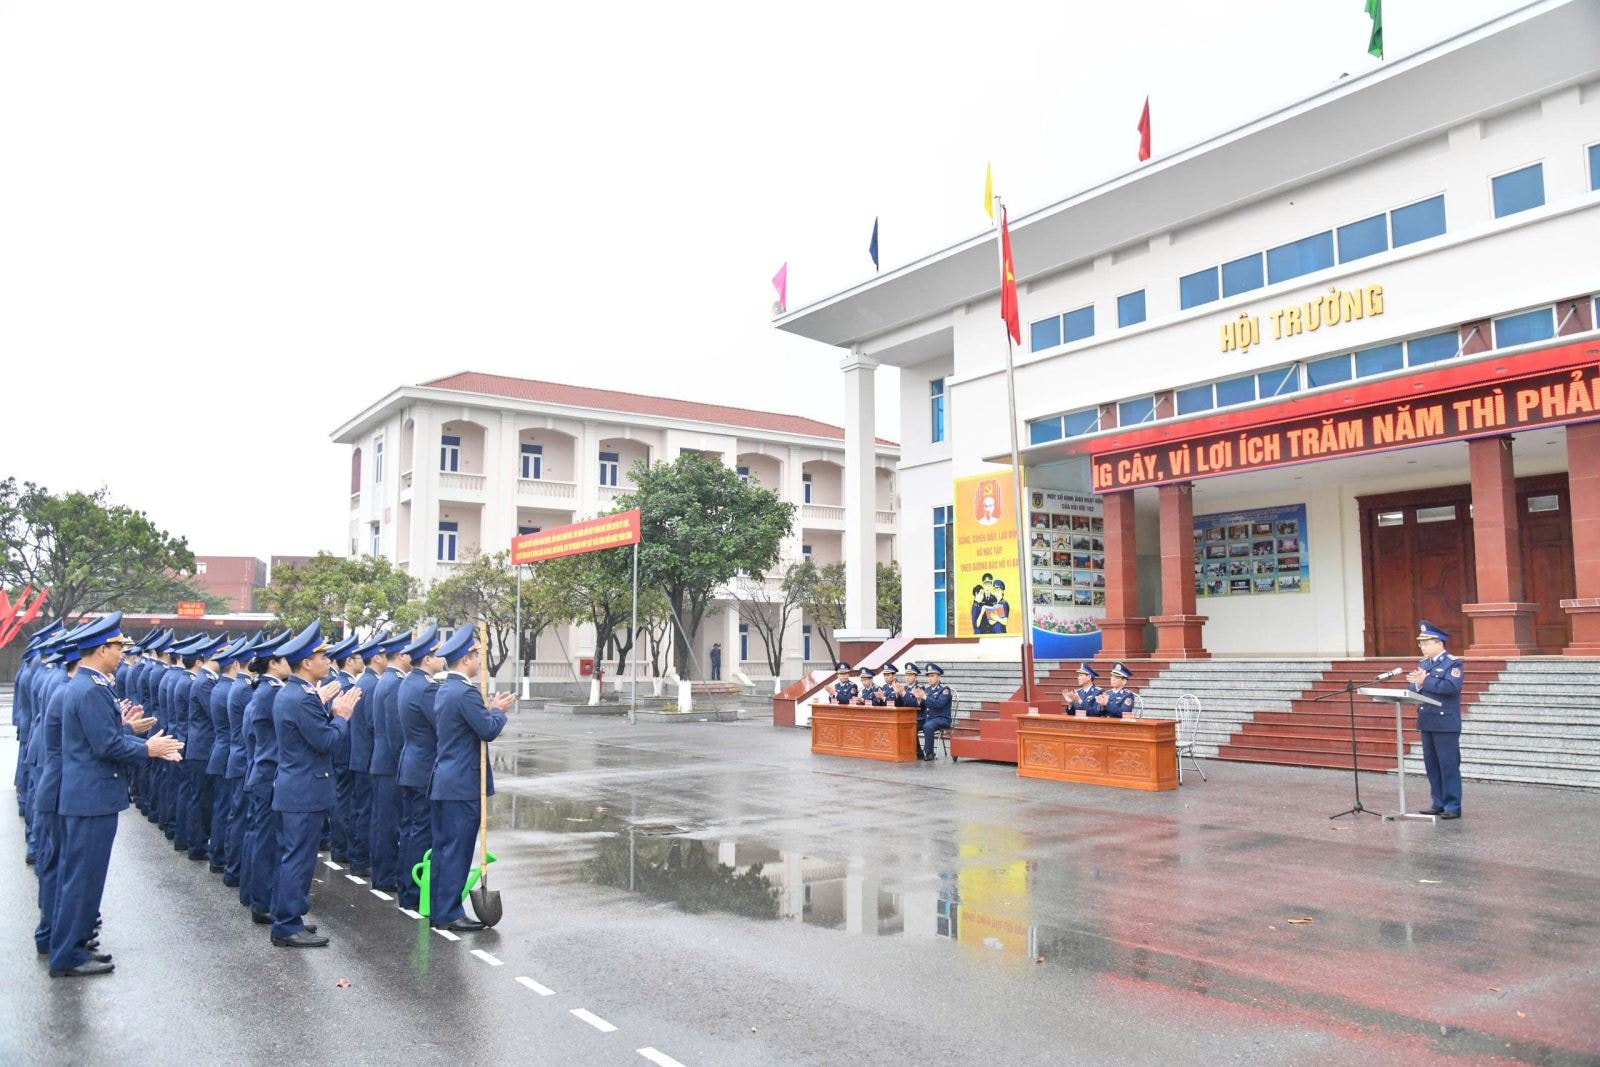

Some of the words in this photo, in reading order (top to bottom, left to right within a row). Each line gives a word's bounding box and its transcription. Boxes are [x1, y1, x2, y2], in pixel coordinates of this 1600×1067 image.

[1220, 312, 1260, 353] HỘI
[1270, 285, 1384, 339] TRƯỜNG
[1118, 453, 1163, 484] CÂY,
[1169, 444, 1190, 476] VÌ
[1197, 441, 1232, 472] LỢI
[1239, 434, 1281, 465] ÍCH
[1287, 418, 1364, 458] TRĂM
[1372, 404, 1444, 445] NĂM
[1453, 388, 1506, 431] THÌ
